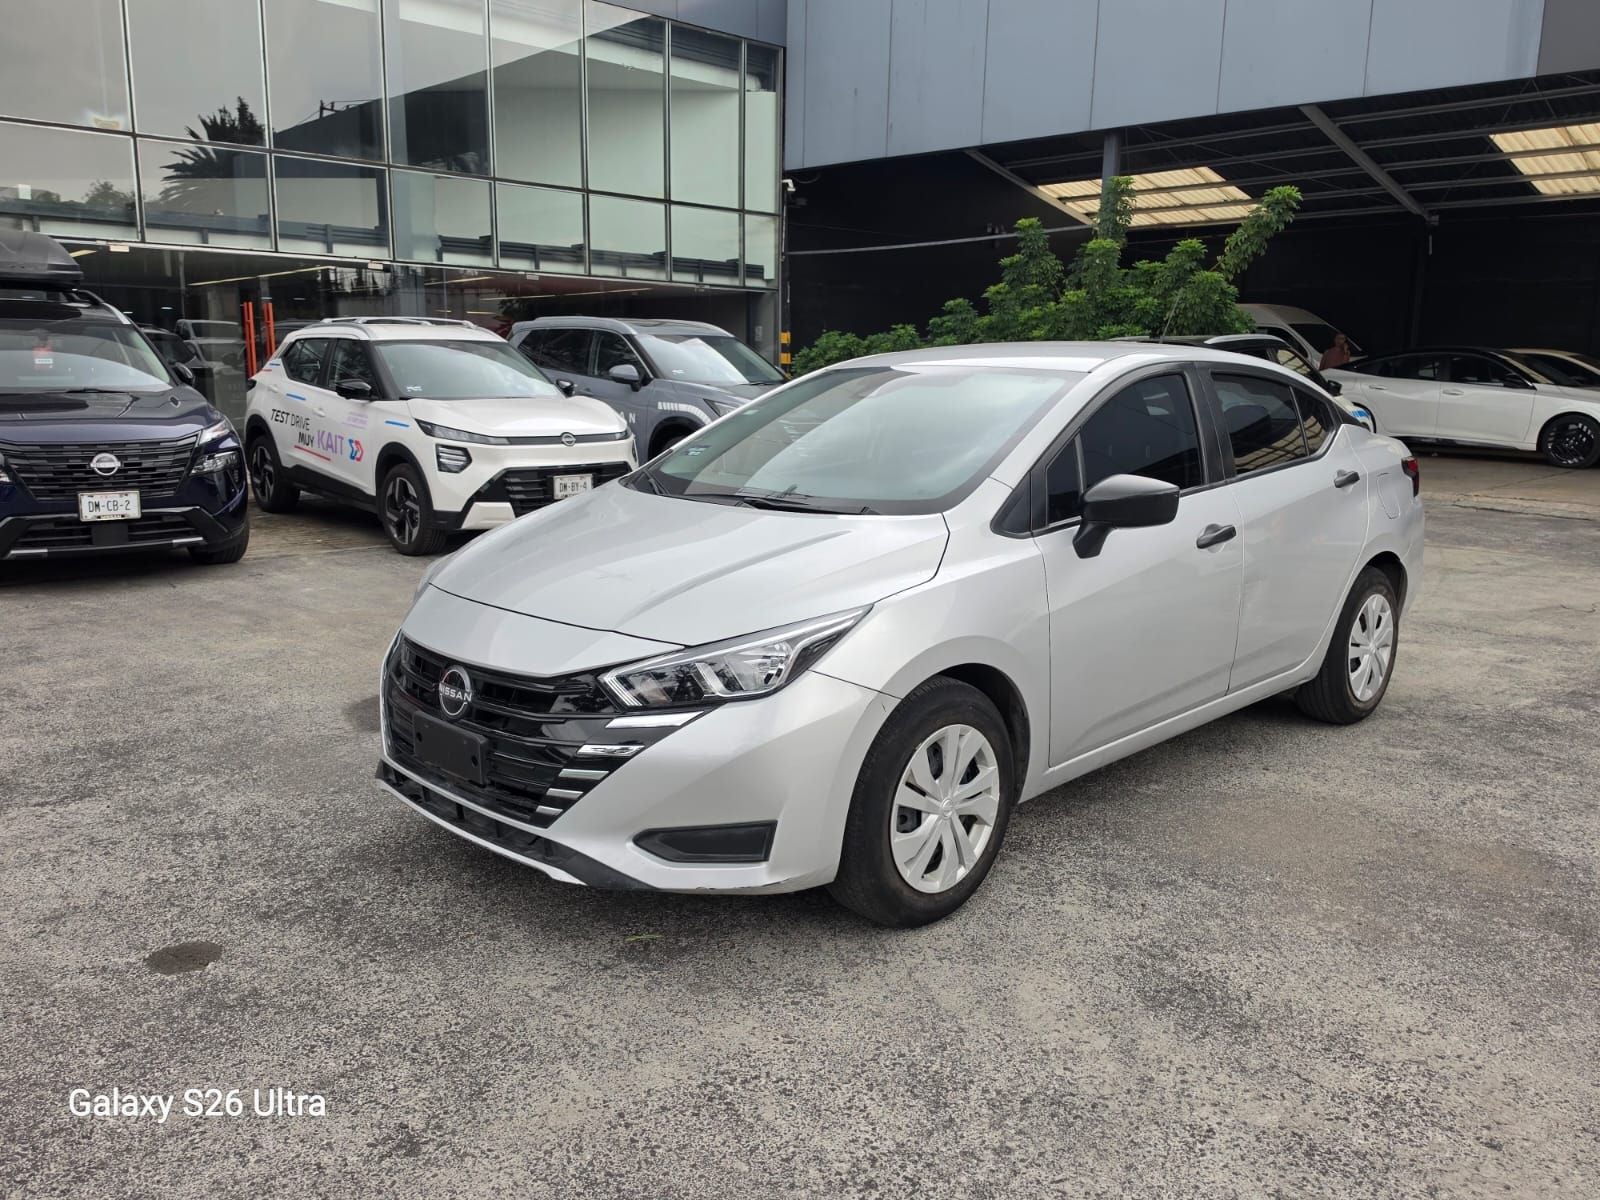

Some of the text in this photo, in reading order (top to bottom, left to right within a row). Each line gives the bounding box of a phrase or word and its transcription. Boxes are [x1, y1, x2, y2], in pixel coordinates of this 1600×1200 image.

[270, 408, 310, 431] TEST DRIVE
[298, 429, 345, 455] MUY KAIT
[88, 499, 131, 513] DM-CB-2
[438, 683, 473, 702] NISSAN
